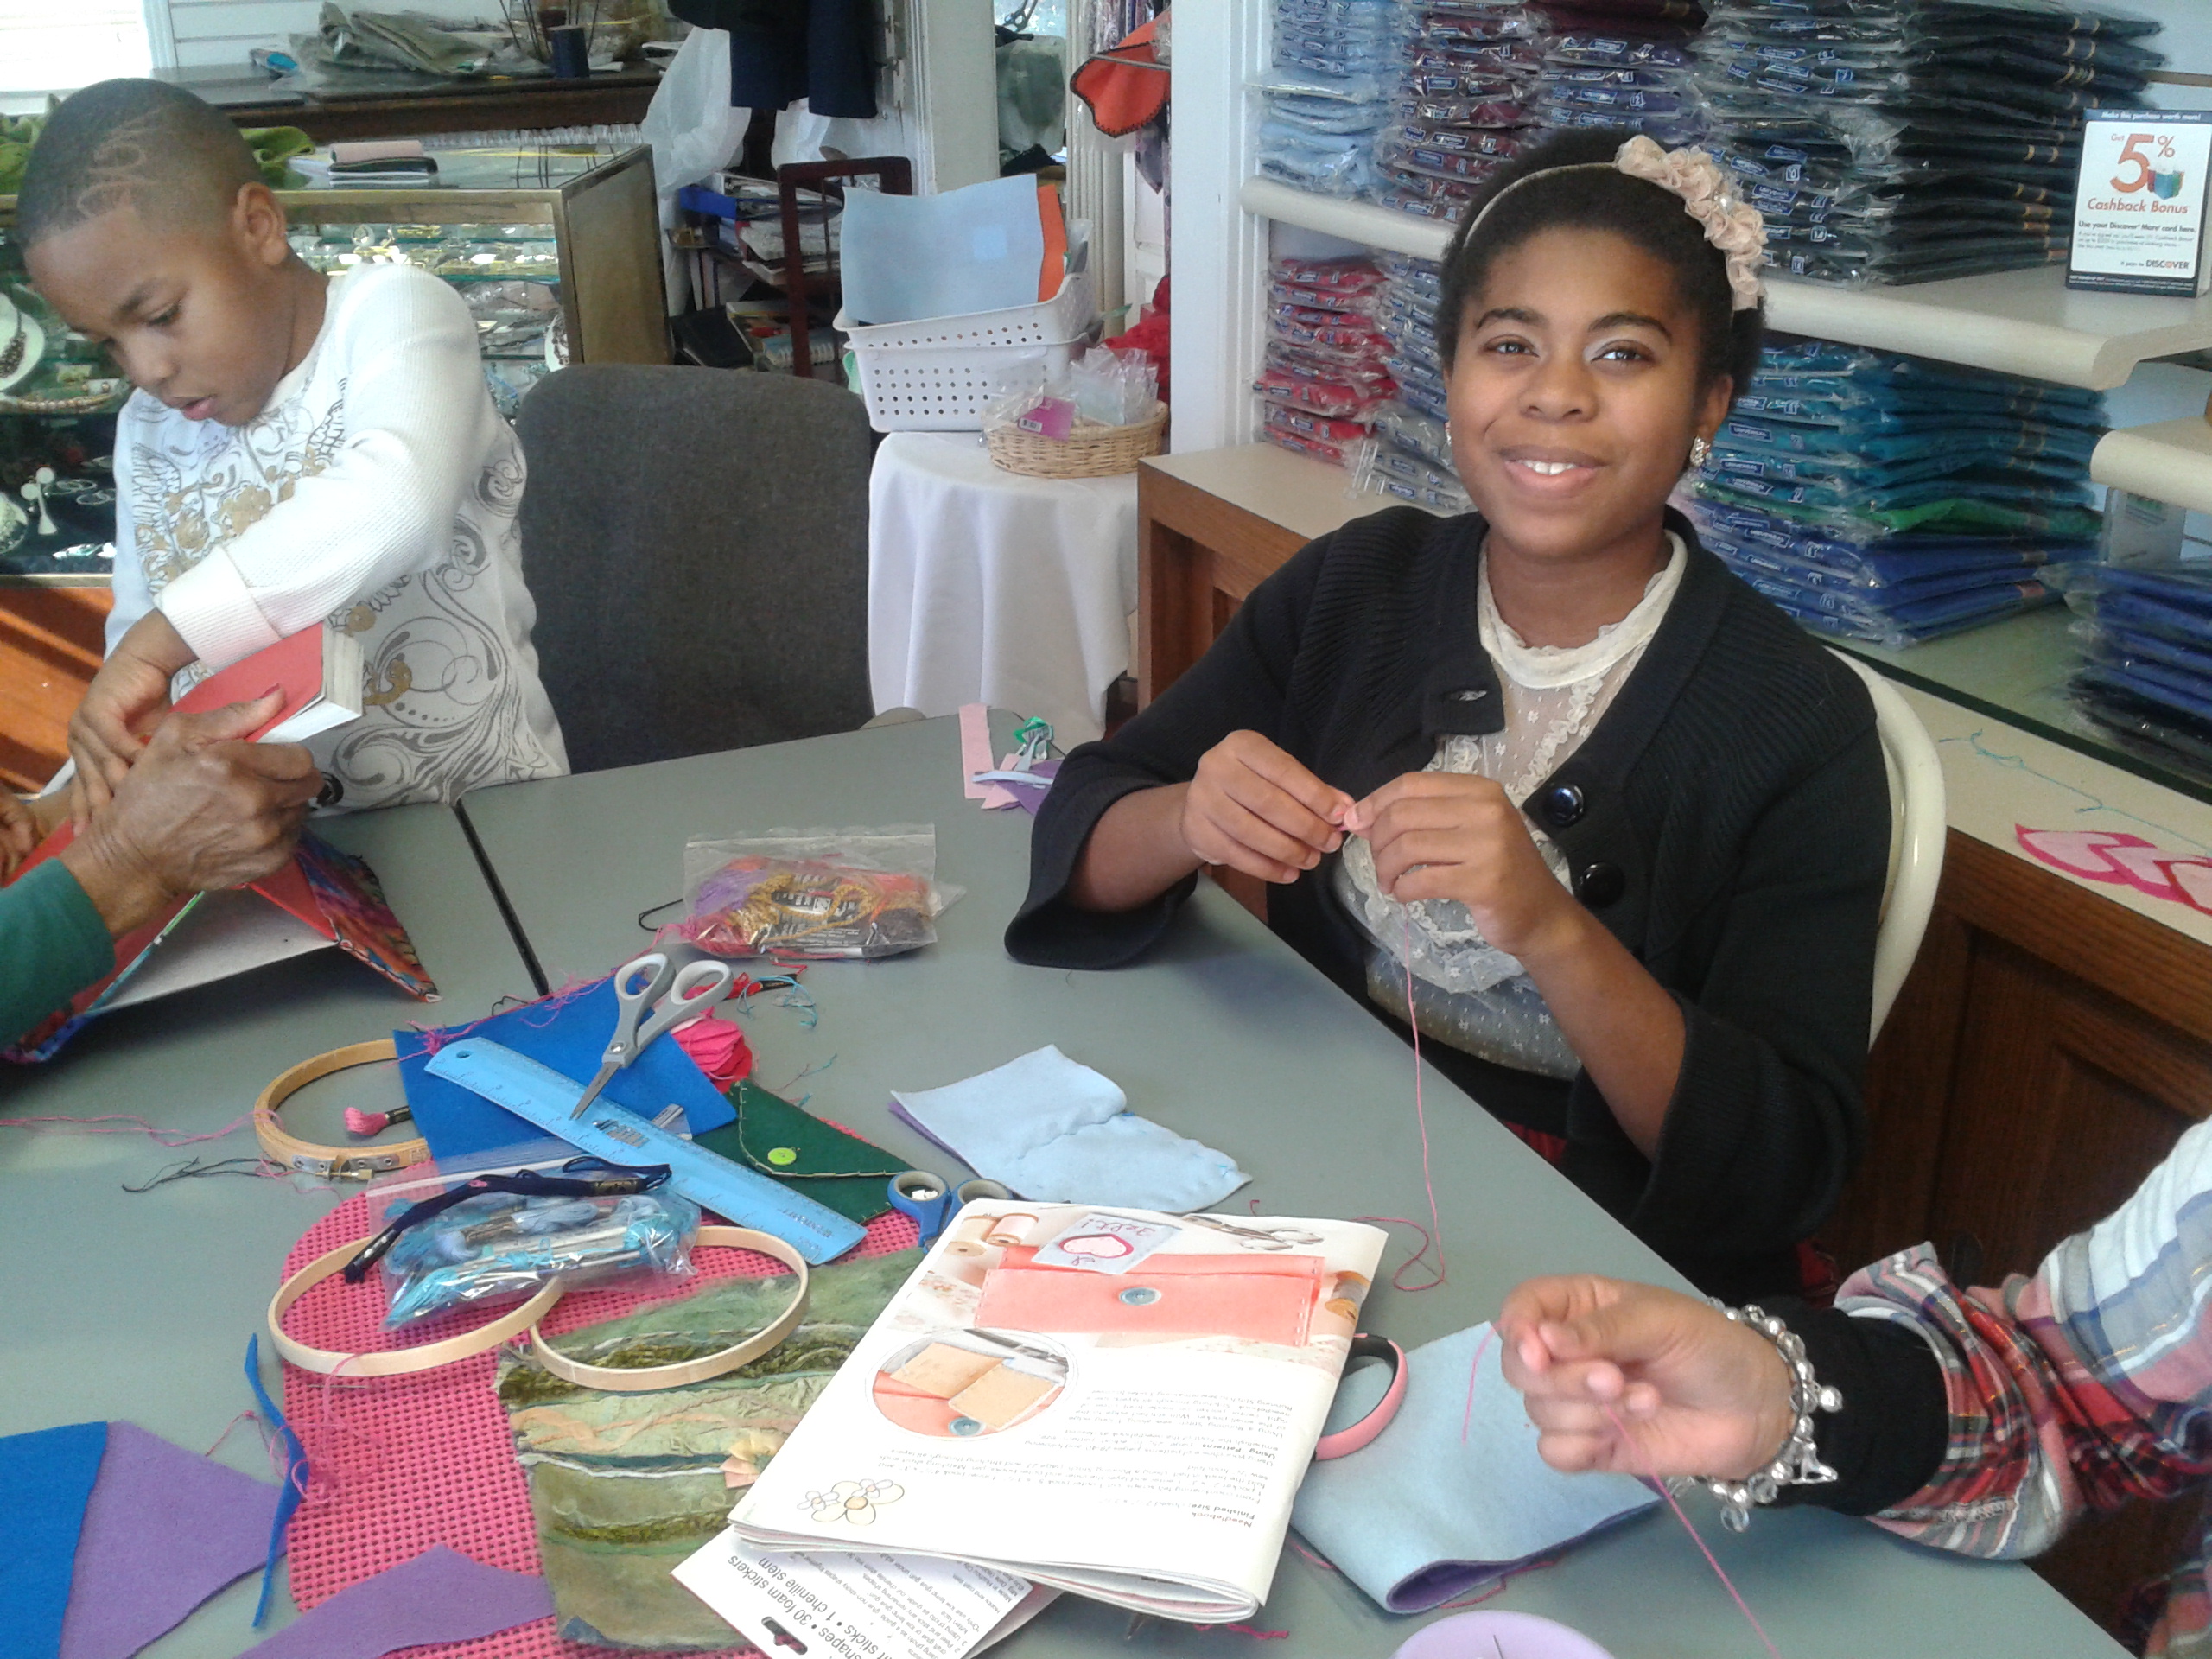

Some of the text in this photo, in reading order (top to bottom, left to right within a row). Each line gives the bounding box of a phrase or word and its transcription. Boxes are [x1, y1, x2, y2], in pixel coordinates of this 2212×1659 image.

[2088, 198, 2188, 213] Cashback Bonus
[2146, 260, 2189, 269] DISCOVER
[1249, 1448, 1275, 1460] Using
[1192, 1512, 1252, 1528] Needlebook
[1214, 1506, 1255, 1520] Finished
[728, 1555, 769, 1590] stickers
[758, 1557, 879, 1654] sticks 1 chenille stem
[767, 1586, 797, 1613] foam
[793, 1609, 812, 1626] 30
